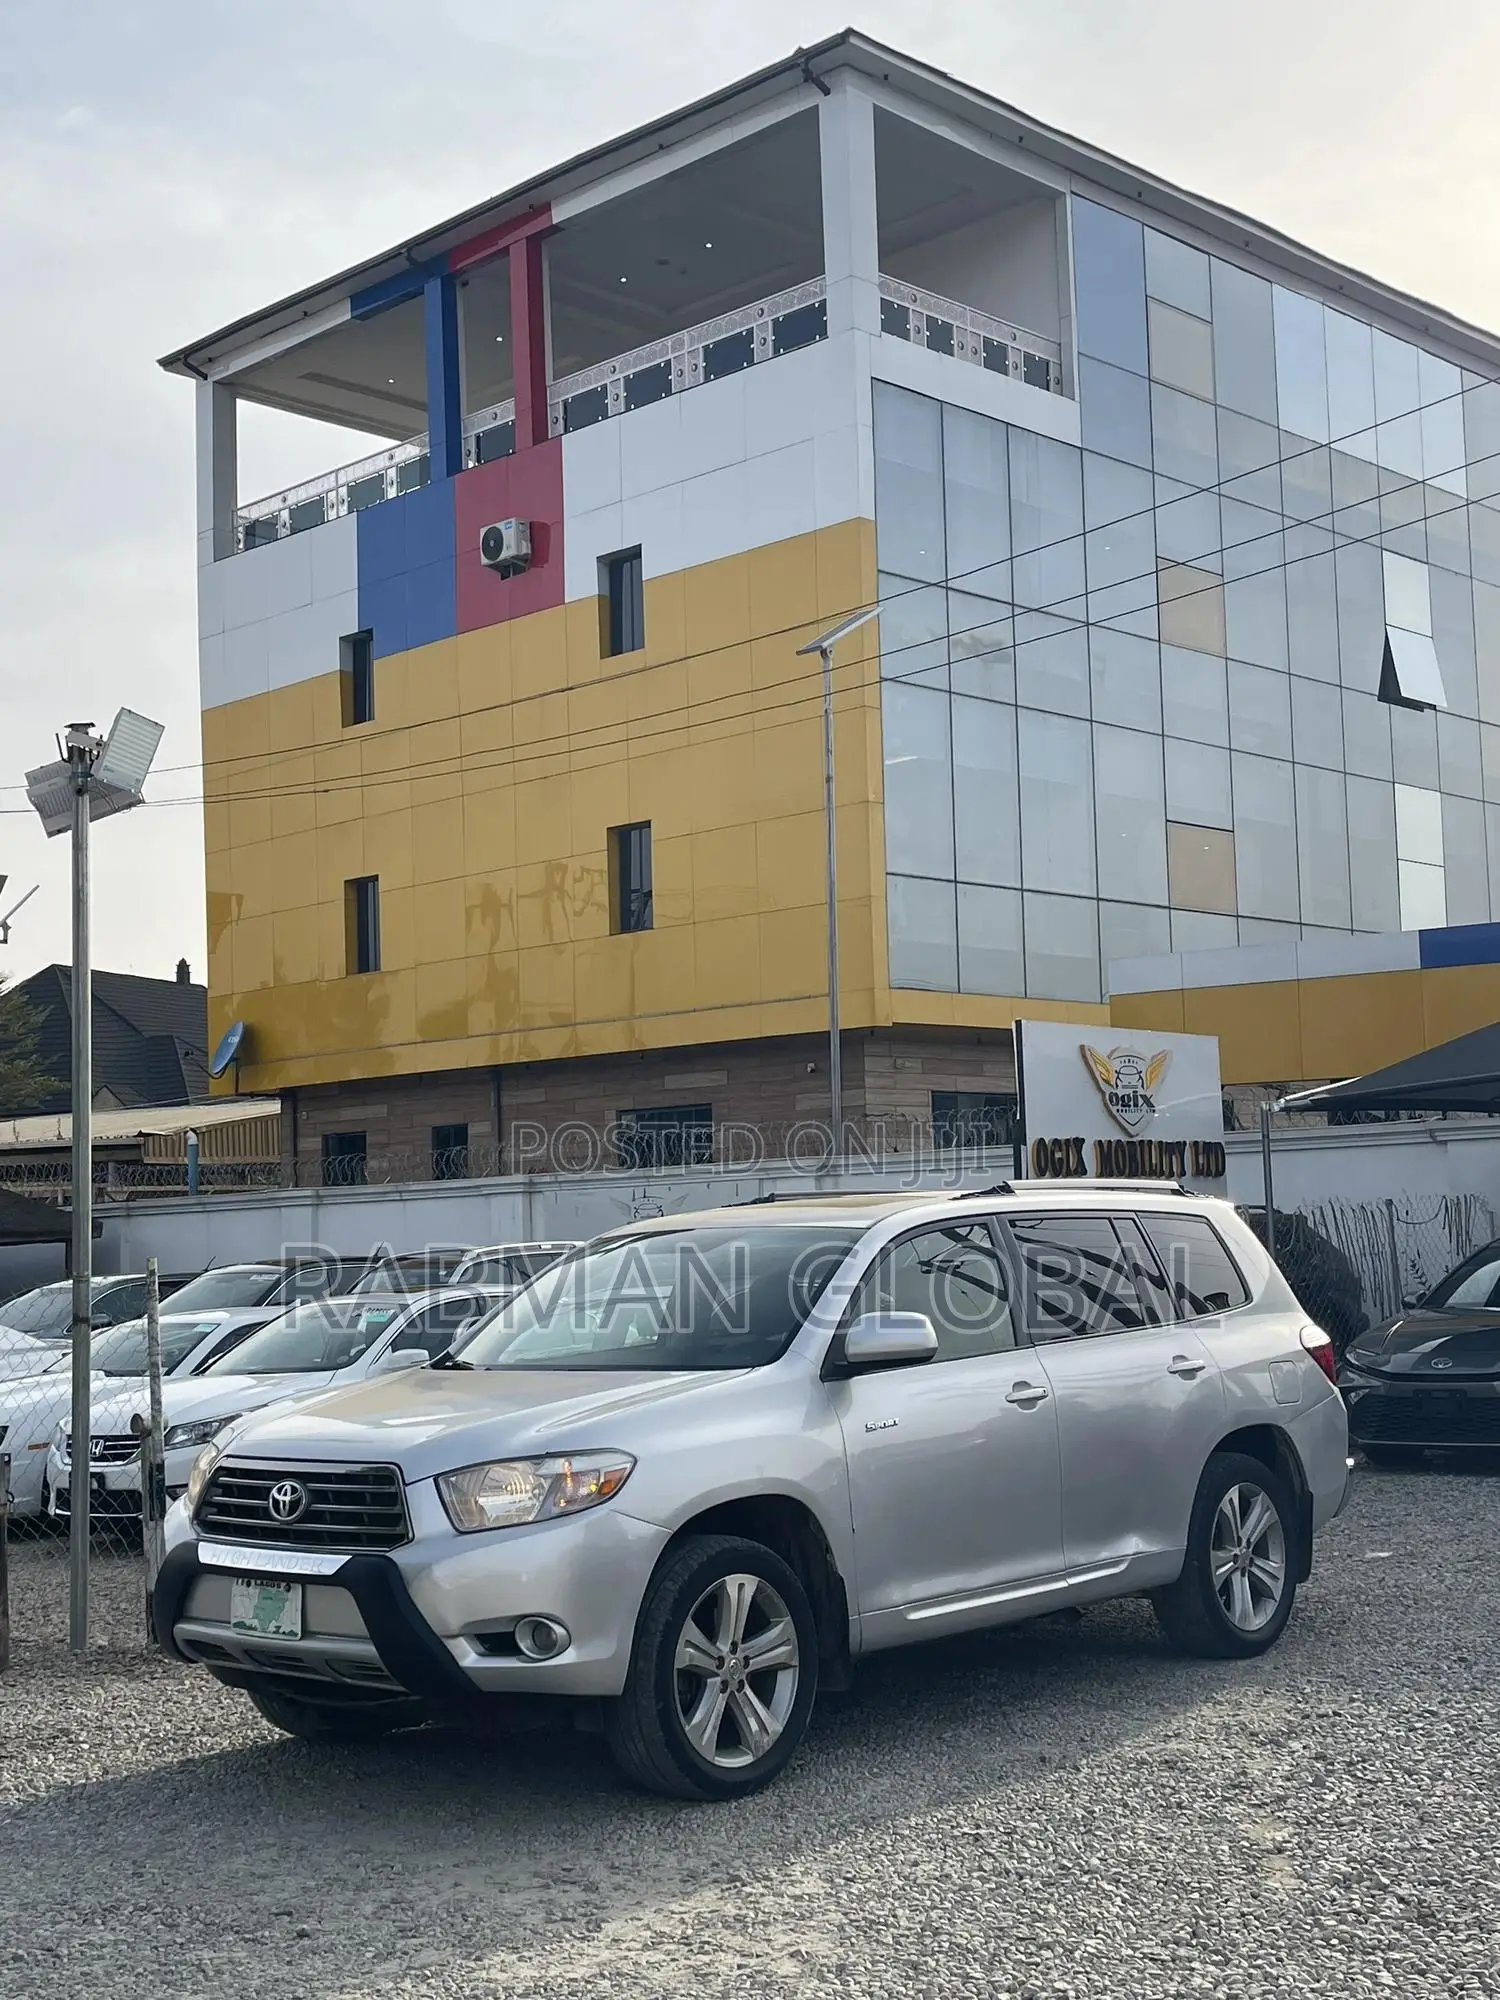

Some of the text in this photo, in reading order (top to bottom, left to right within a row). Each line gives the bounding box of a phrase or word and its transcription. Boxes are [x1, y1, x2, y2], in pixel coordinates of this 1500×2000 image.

[1108, 1090, 1155, 1108] ogix
[1032, 1137, 1226, 1178] OGIX MOBILITY LTD
